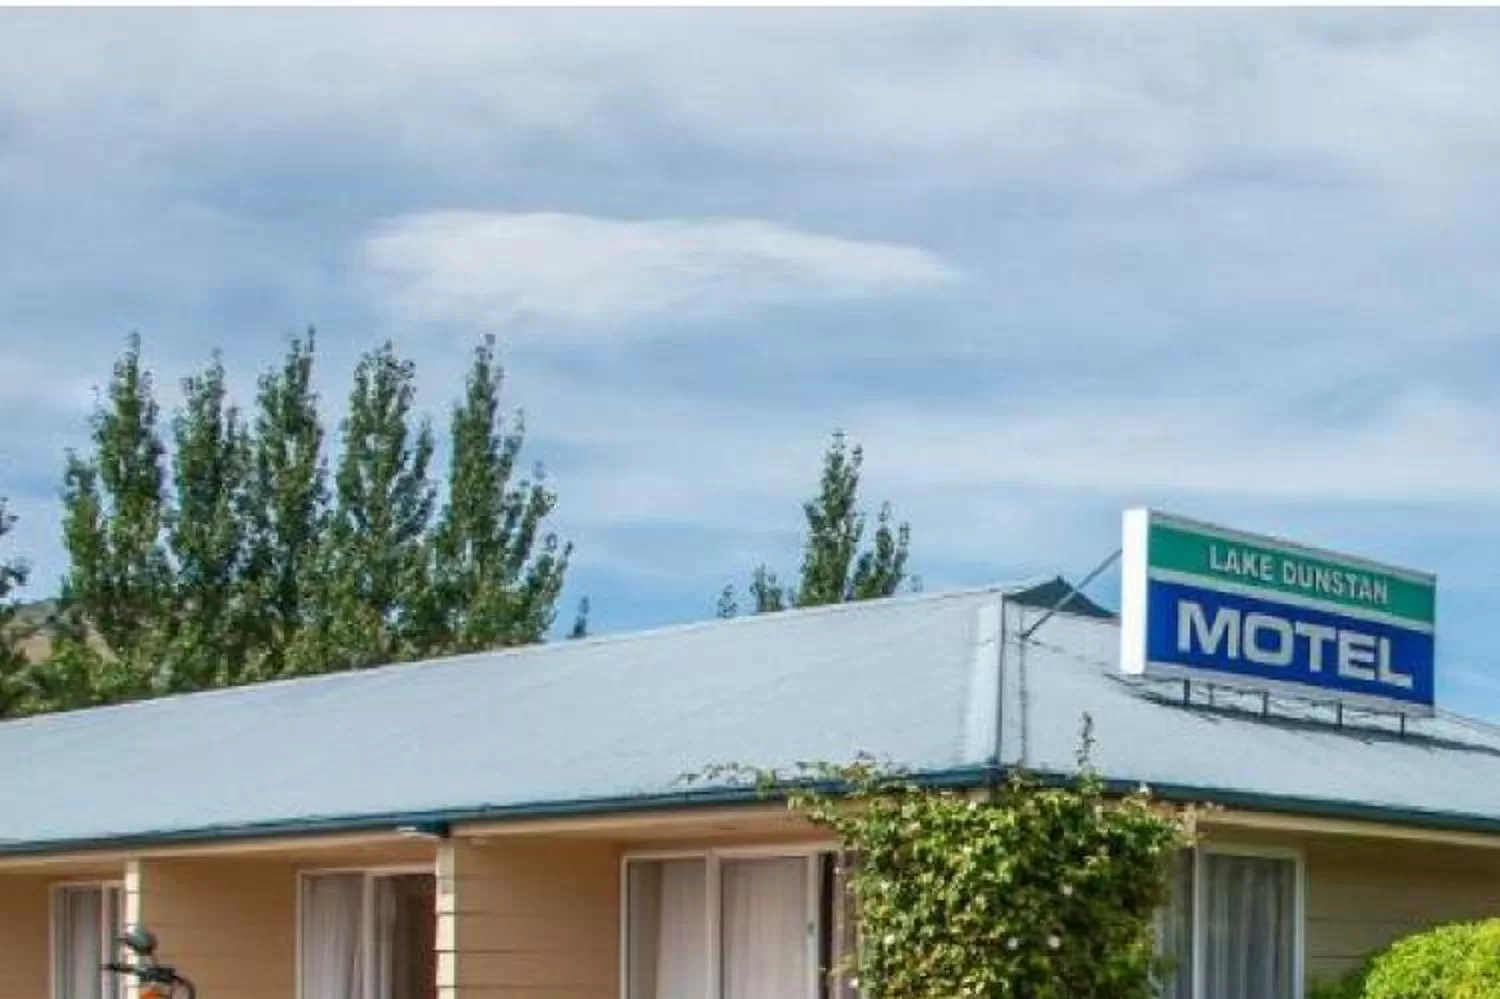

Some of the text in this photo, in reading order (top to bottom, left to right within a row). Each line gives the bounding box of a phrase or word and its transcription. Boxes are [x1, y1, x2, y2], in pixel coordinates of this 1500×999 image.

[1209, 545, 1388, 604] LAKE DUNSTAN
[1177, 600, 1413, 688] MOTEL
